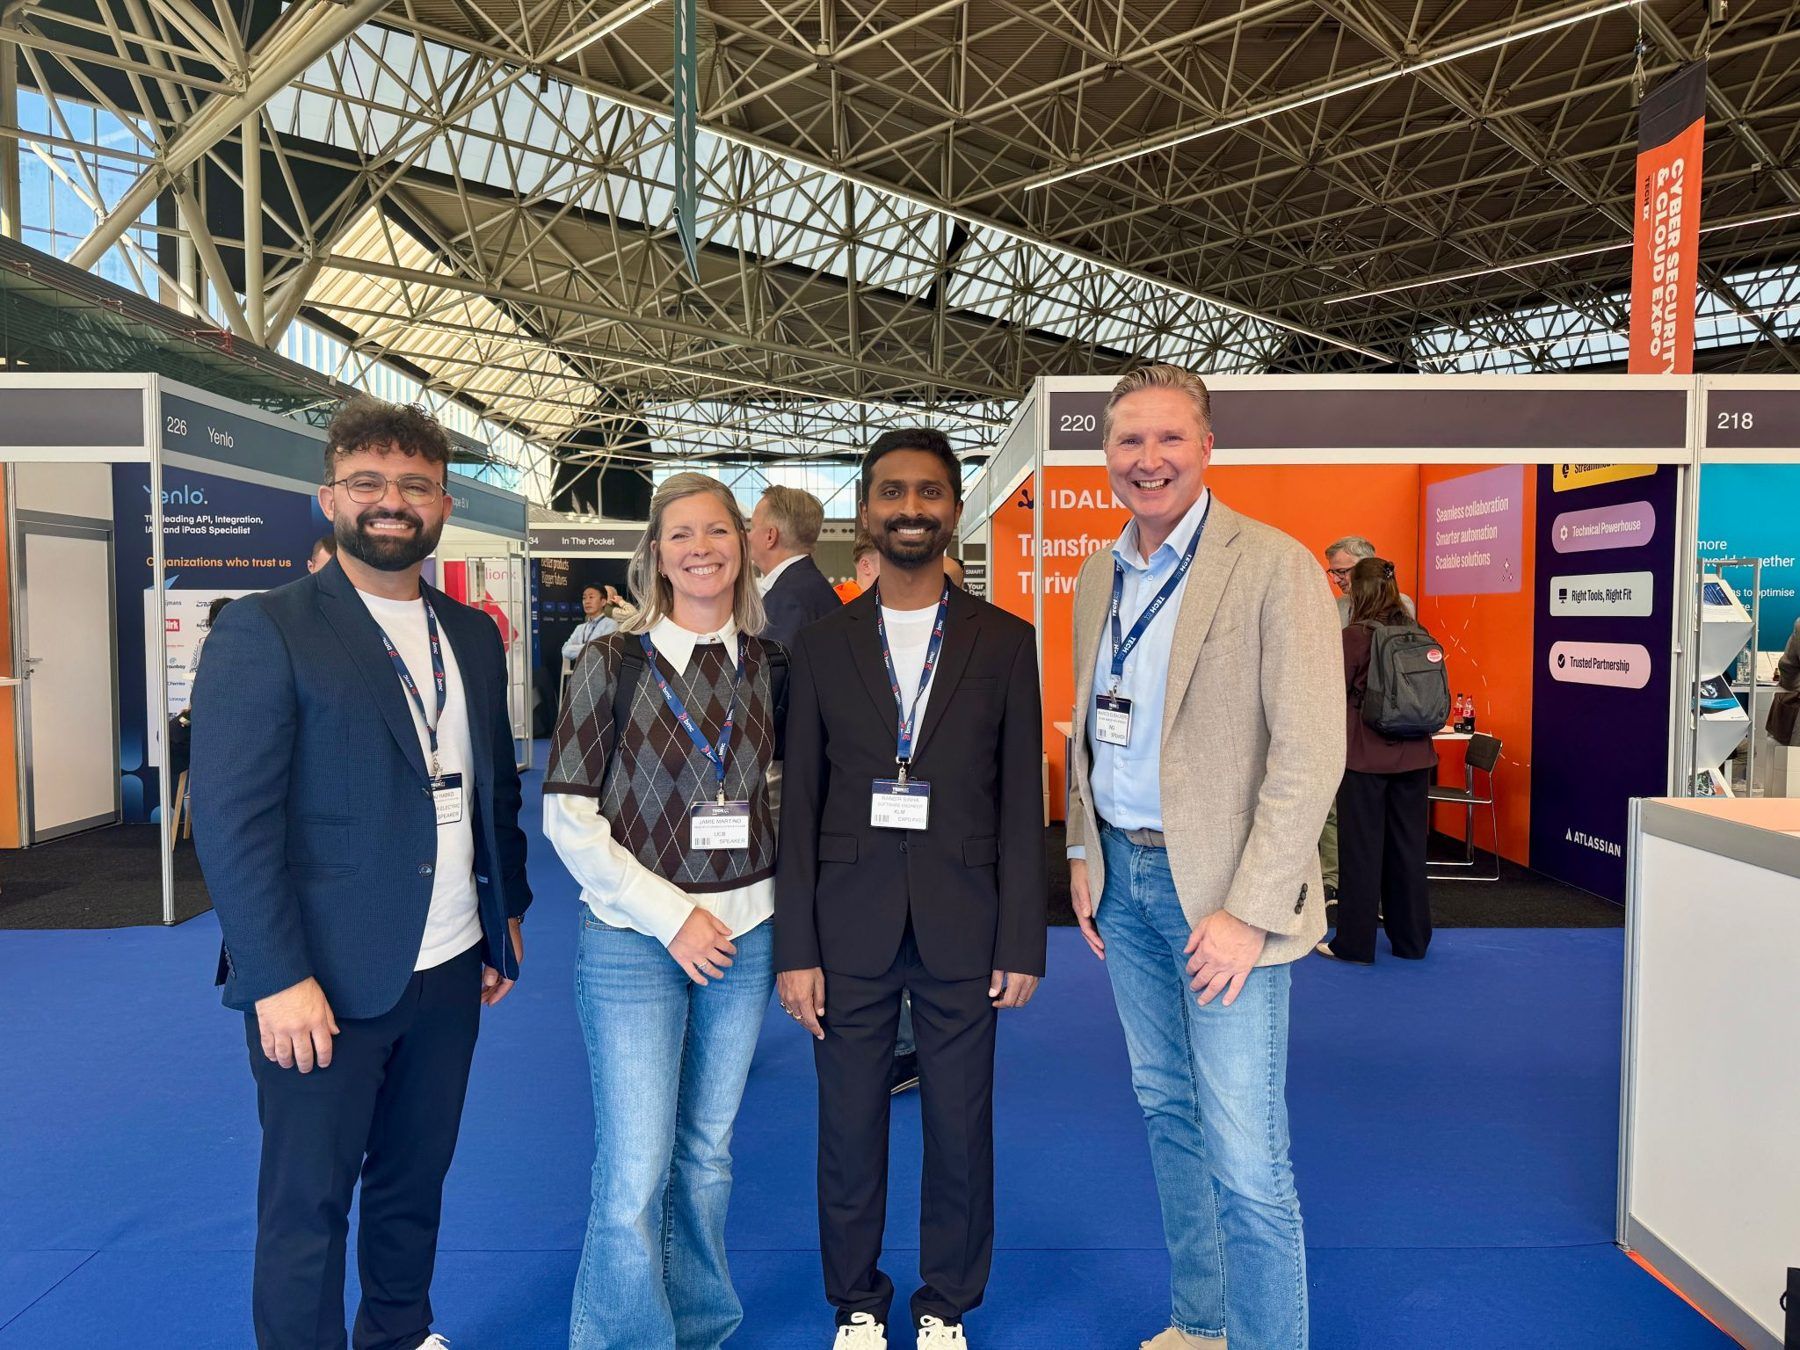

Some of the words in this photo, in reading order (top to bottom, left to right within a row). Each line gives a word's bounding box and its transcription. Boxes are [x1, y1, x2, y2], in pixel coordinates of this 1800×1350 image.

[1656, 167, 1669, 188] &
[1667, 158, 1684, 249] CYBER
[1652, 192, 1668, 282] CLOUD
[1650, 285, 1664, 356] EXPO
[1661, 252, 1679, 375] SECURITY
[167, 416, 188, 436] 226
[1060, 414, 1096, 432] 220
[1717, 412, 1753, 429] 218
[207, 426, 234, 448] Yenlo
[1436, 504, 1464, 523] Seamless
[1464, 496, 1509, 518] collaboration
[163, 515, 194, 525] leading
[196, 515, 213, 524] API,
[215, 515, 264, 525] Integration,
[1572, 523, 1600, 538] Technical
[1600, 518, 1641, 535] Powerhouse
[163, 526, 180, 534] and
[182, 526, 207, 534] iPaaS
[208, 526, 251, 536] Specialist
[1435, 530, 1460, 546] Smarter
[1461, 523, 1498, 543] automation
[561, 537, 568, 545] In
[570, 537, 585, 545] The
[588, 536, 615, 546] Pocket
[1697, 541, 1727, 550] more
[225, 557, 250, 567] who
[252, 558, 276, 567] trust
[278, 559, 292, 567] us
[1435, 553, 1460, 570] Scalable
[1461, 551, 1491, 567] solutions
[1571, 590, 1587, 604] Right
[1587, 589, 1605, 603] Tools,
[1605, 588, 1622, 604] Right
[1622, 588, 1632, 601] Fit
[1744, 588, 1753, 597] to
[927, 651, 935, 664] bmc
[1570, 656, 1592, 670] Trusted
[1592, 658, 1630, 674] Partnership
[662, 687, 672, 700] bmc
[683, 719, 694, 733] bmc
[1573, 831, 1621, 857] ATLASSIAN
